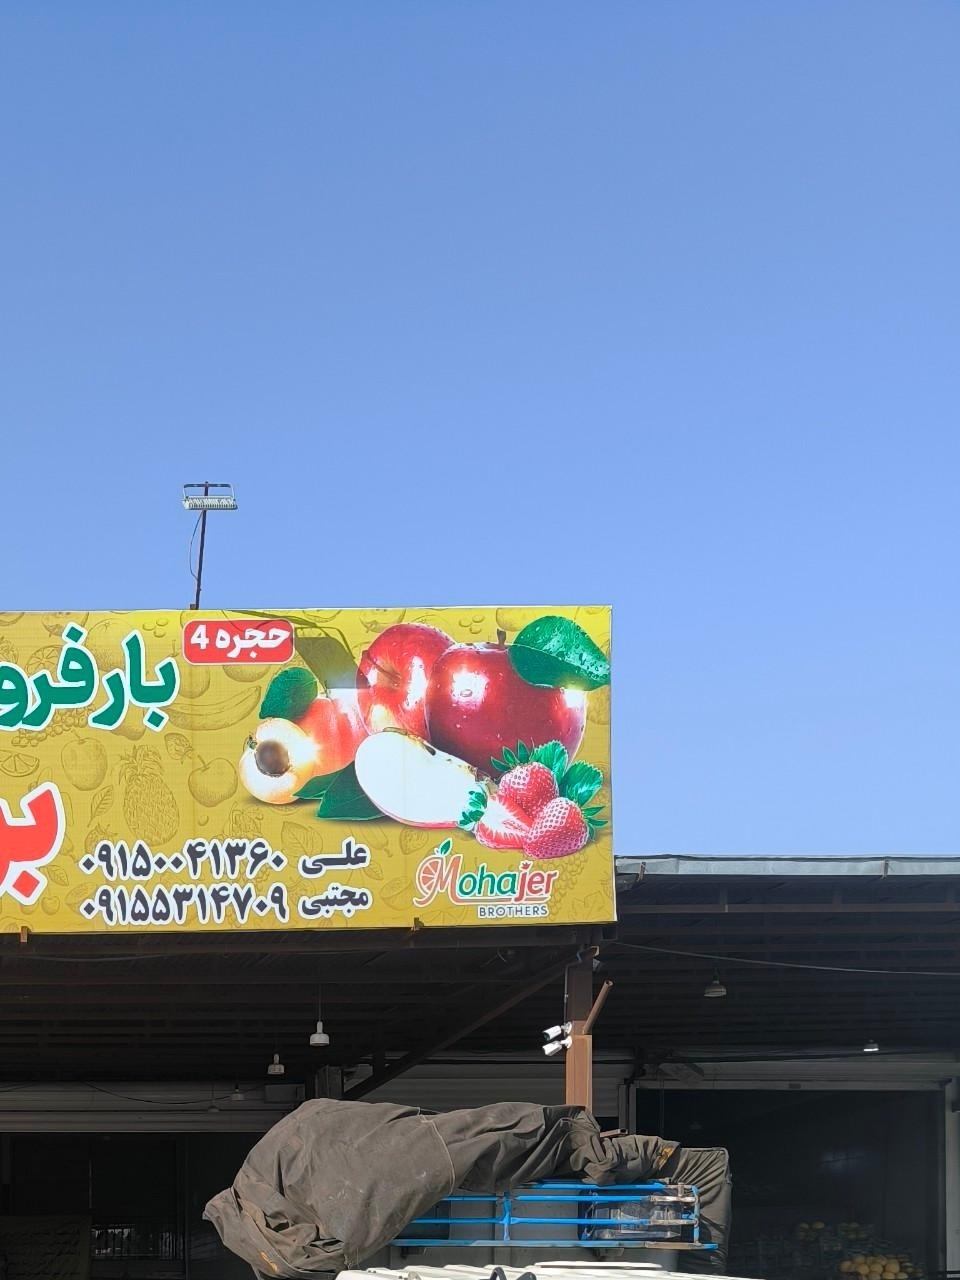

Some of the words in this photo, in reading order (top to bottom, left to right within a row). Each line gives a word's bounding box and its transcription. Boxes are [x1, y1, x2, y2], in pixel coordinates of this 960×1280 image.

[189, 623, 210, 650] 4
[215, 626, 291, 659] حجره
[413, 853, 559, 907] Mohajer
[300, 885, 370, 917] مجتبی
[478, 905, 549, 918] BROTHERS
